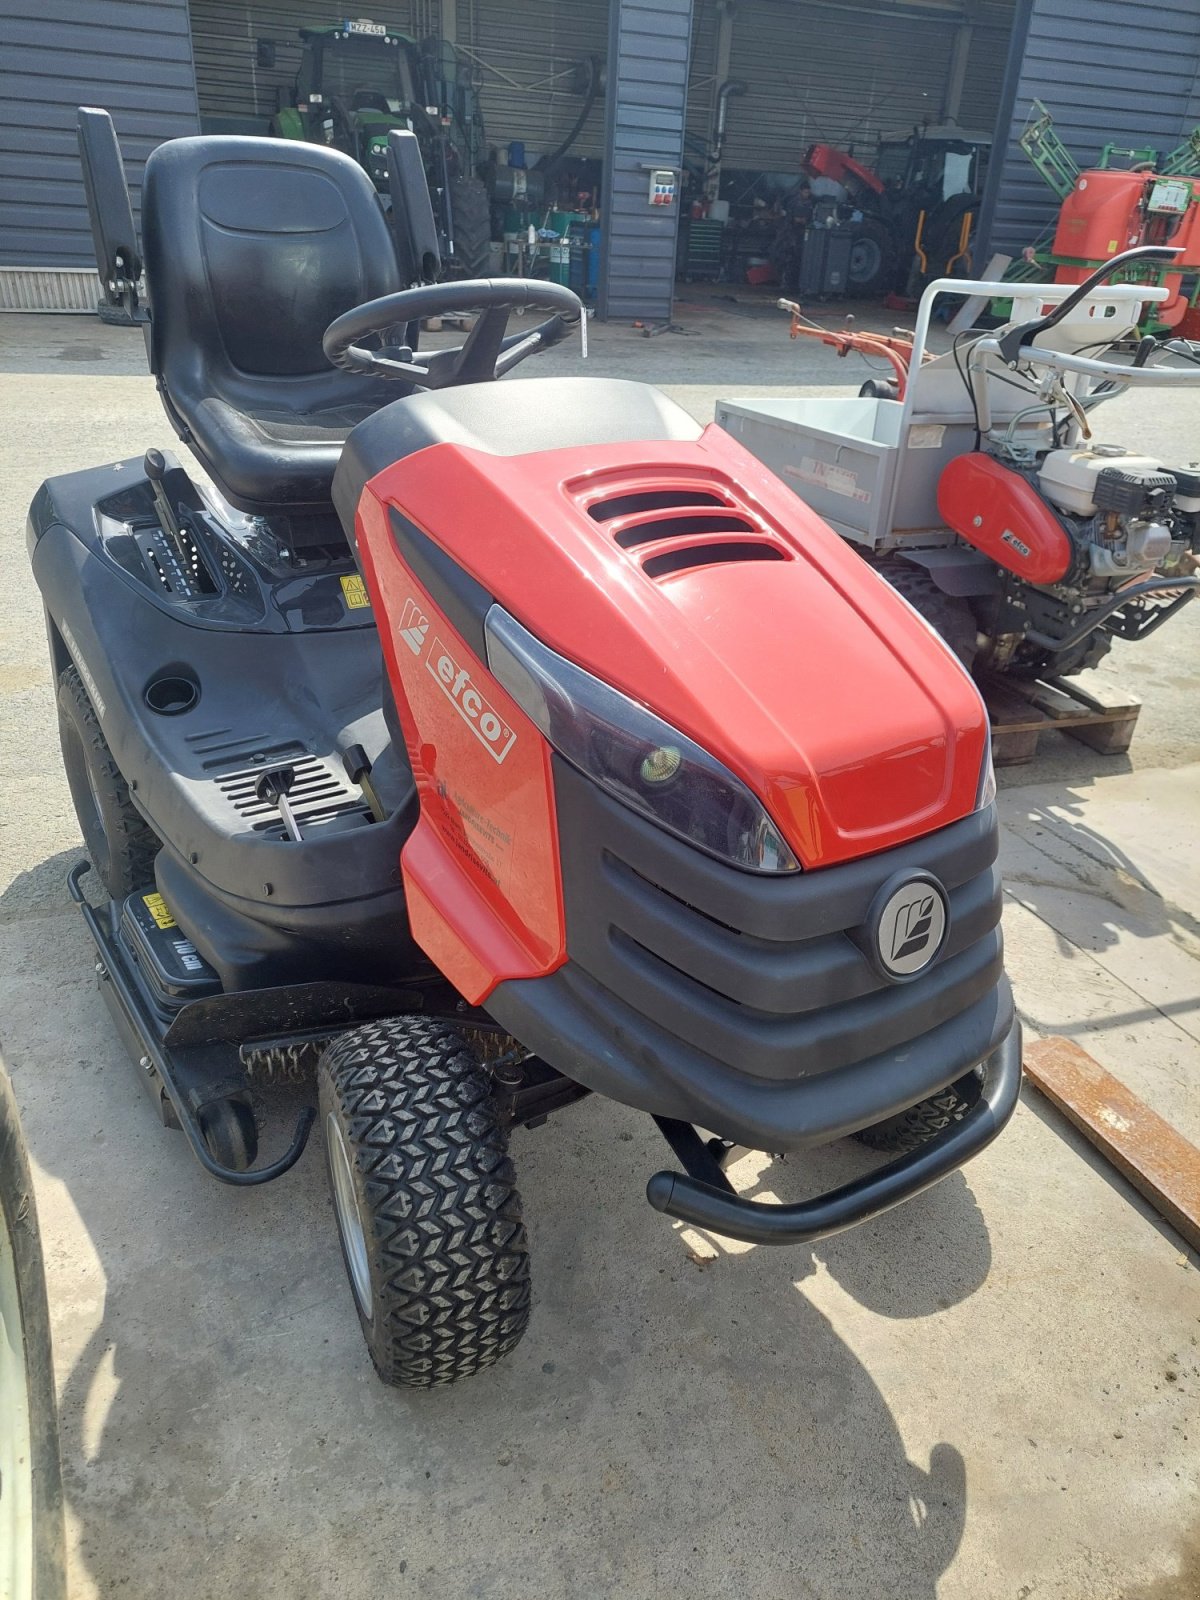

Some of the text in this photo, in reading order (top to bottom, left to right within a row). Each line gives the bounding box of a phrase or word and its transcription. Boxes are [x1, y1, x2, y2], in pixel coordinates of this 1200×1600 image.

[351, 23, 384, 34] MZZ-454
[1012, 539, 1028, 554] efco
[438, 656, 502, 742] efco
[172, 939, 203, 971] 110 cm
